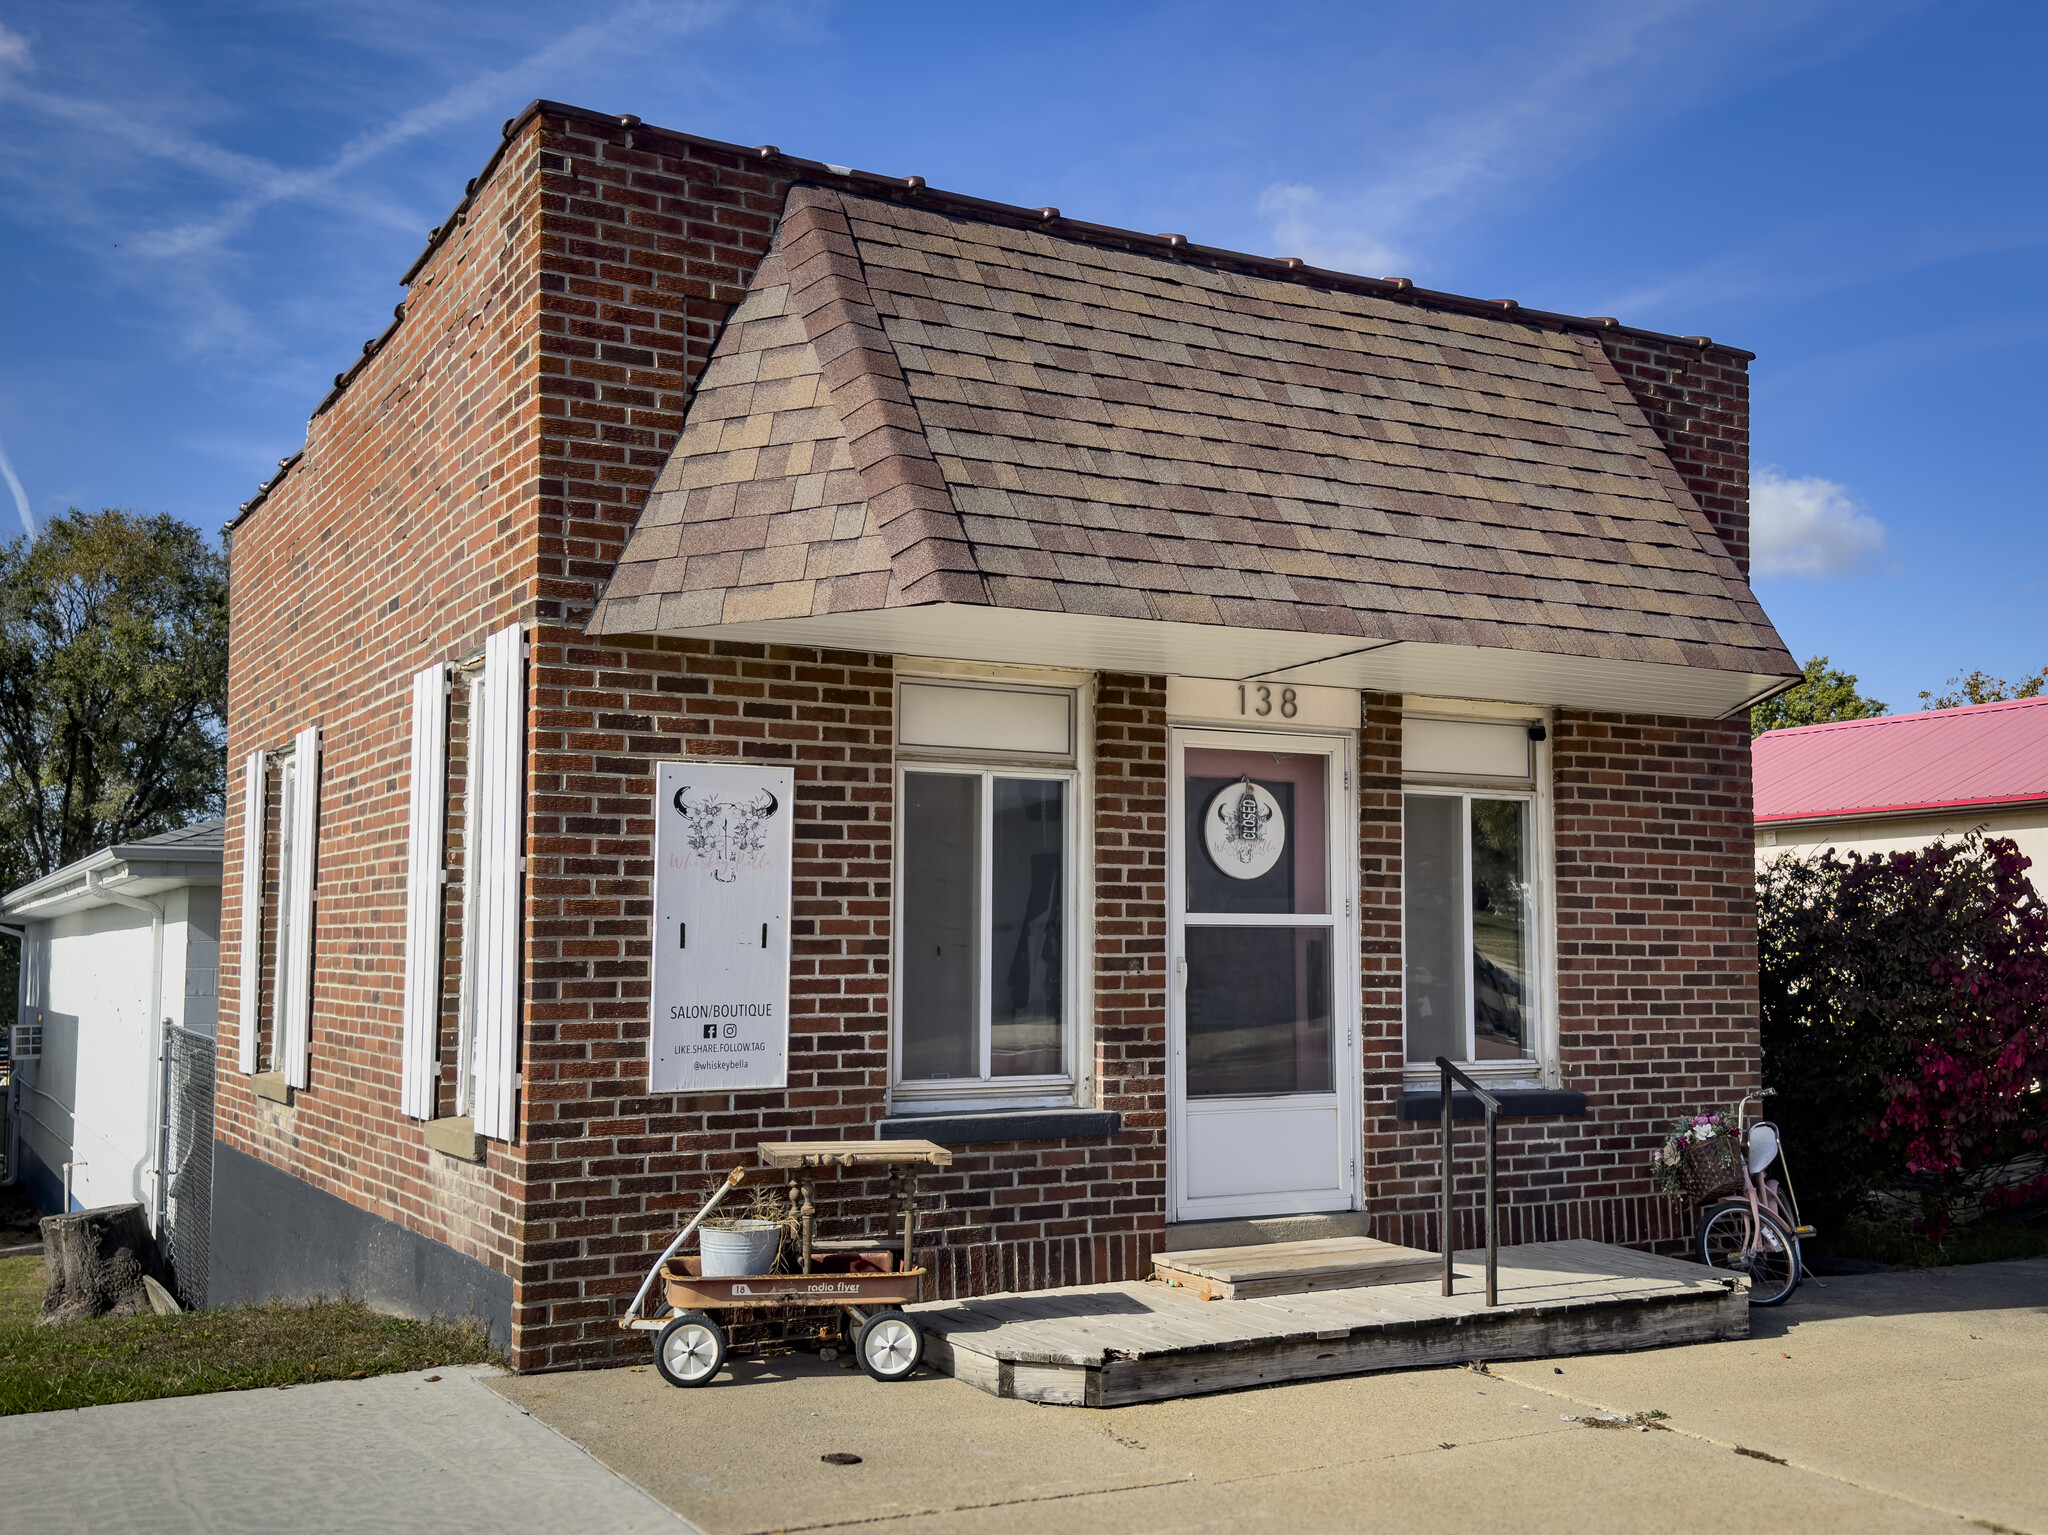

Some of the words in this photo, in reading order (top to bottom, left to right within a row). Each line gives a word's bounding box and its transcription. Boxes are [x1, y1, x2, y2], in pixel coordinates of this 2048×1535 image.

[1237, 684, 1298, 719] 138
[1242, 799, 1257, 840] CLOSED
[670, 1003, 772, 1020] SALON/BOUTIQUE
[674, 1042, 766, 1055] LIKE.SHARE.FOLLOW.TAG
[694, 1059, 749, 1072] @whiskeybella
[736, 1285, 746, 1294] 18
[807, 1283, 834, 1292] radio
[837, 1282, 860, 1293] flyer
